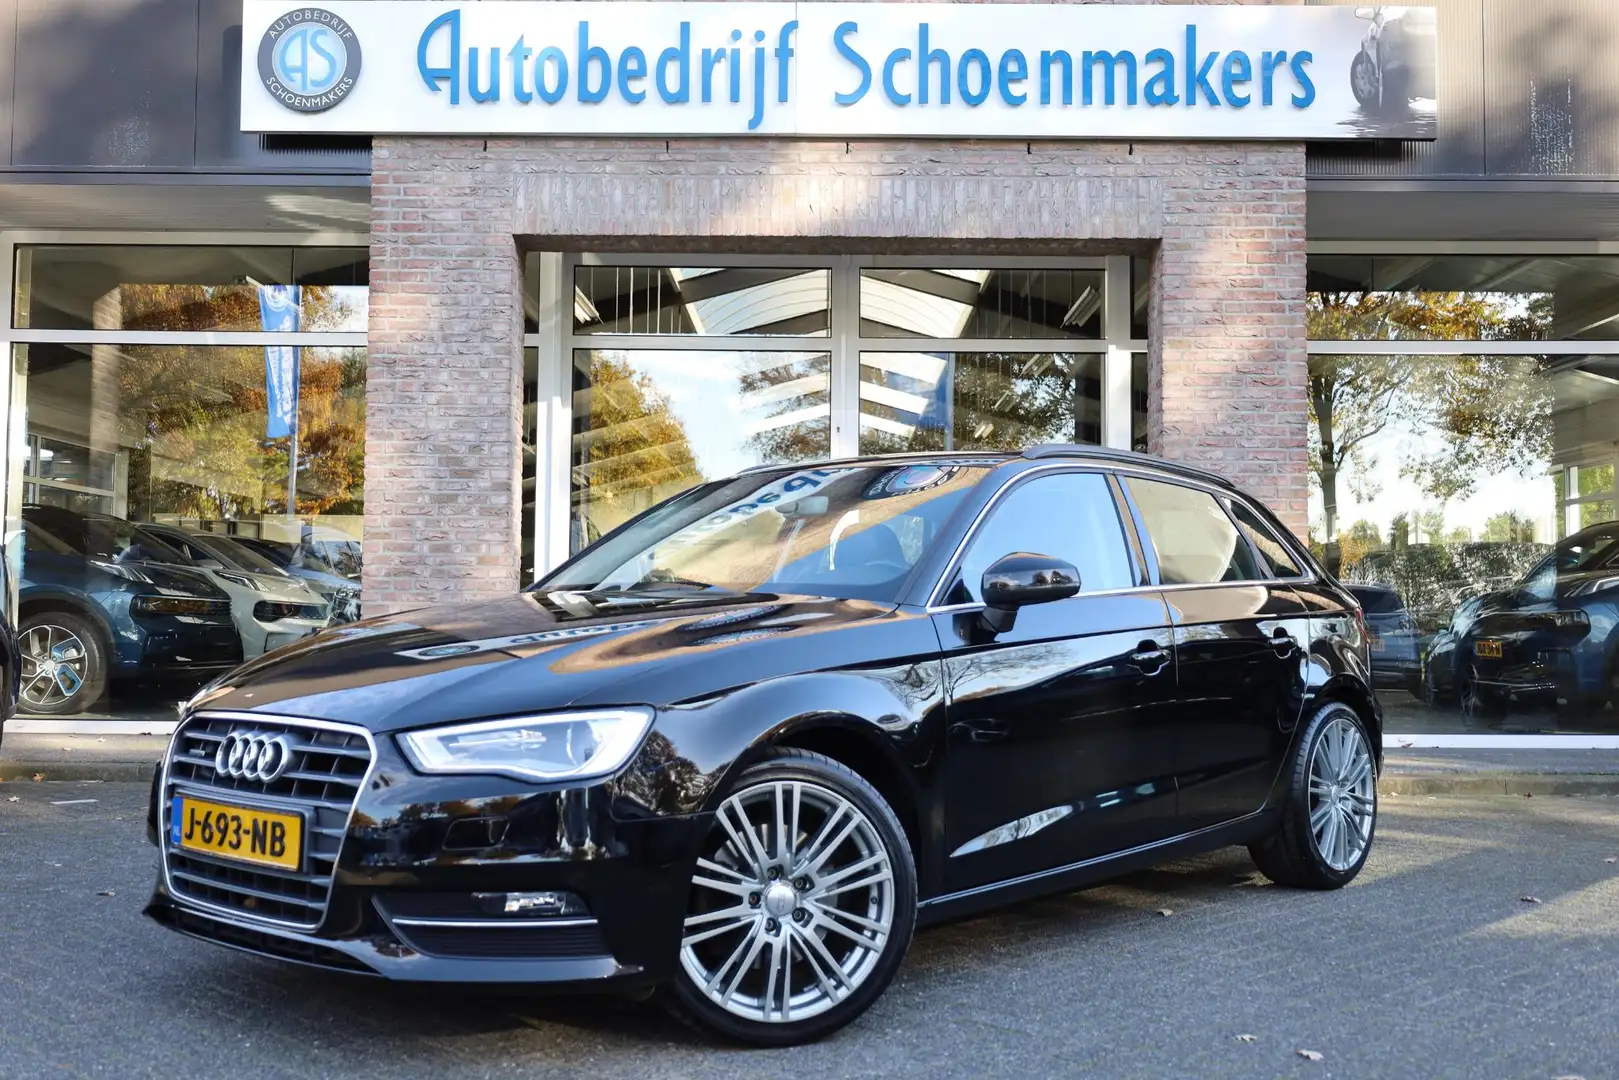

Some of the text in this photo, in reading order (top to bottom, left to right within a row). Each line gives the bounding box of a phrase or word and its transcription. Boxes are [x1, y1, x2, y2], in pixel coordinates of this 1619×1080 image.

[268, 10, 353, 39] AUTOBEDRIJF
[279, 28, 337, 91] AS
[417, 9, 1316, 130] Autobedrijf Schoenmakers
[266, 76, 353, 108] SCHOENMAKERS
[184, 807, 286, 857] J-693-NB
